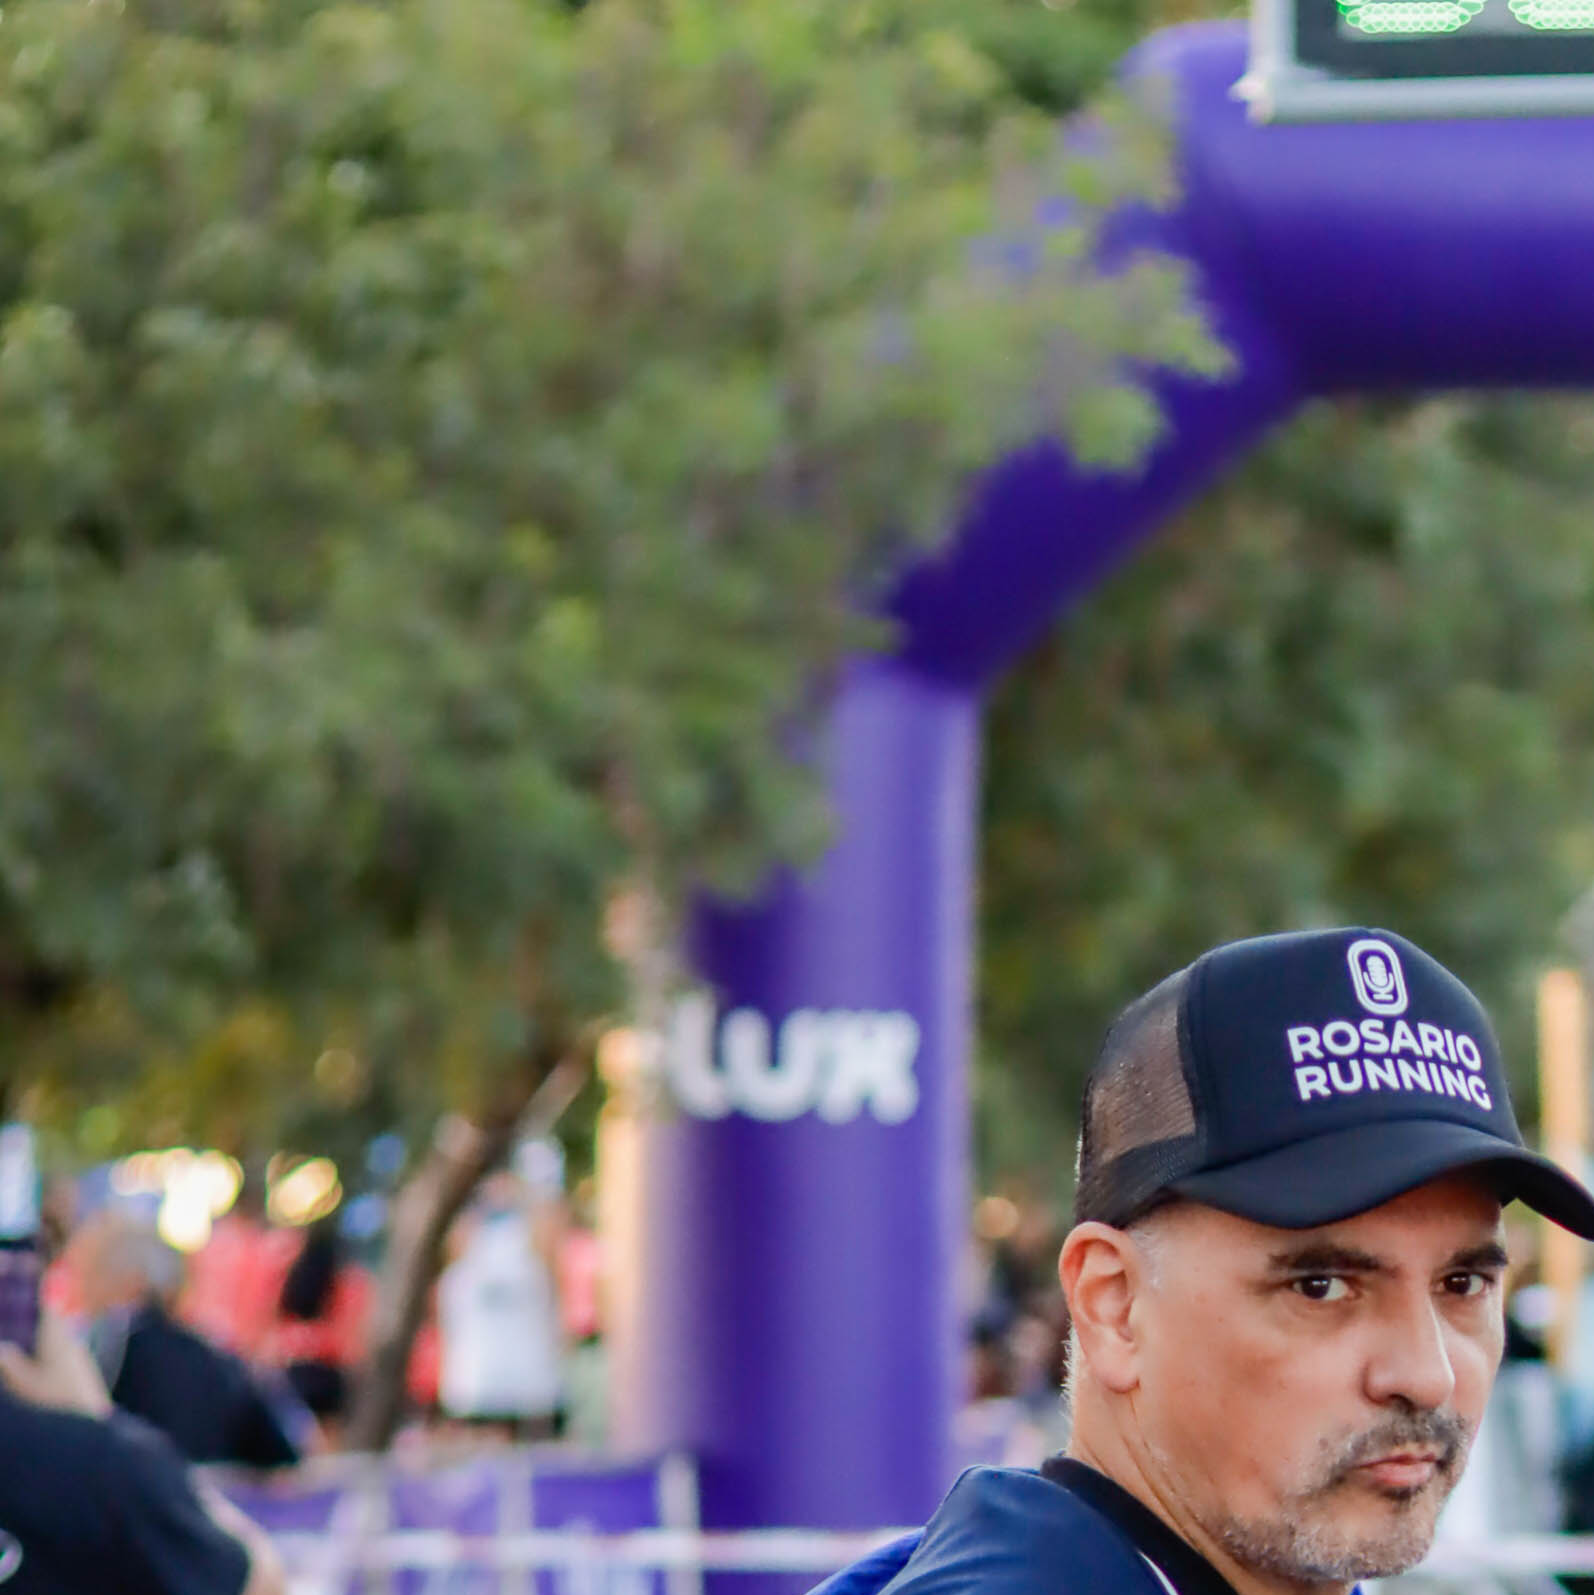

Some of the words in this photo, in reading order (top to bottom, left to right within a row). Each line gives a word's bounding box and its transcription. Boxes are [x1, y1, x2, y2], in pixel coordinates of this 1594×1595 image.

[650, 990, 921, 1127] LUX
[1287, 1018, 1482, 1071] ROSARIO
[1294, 1057, 1493, 1111] RUNNING
